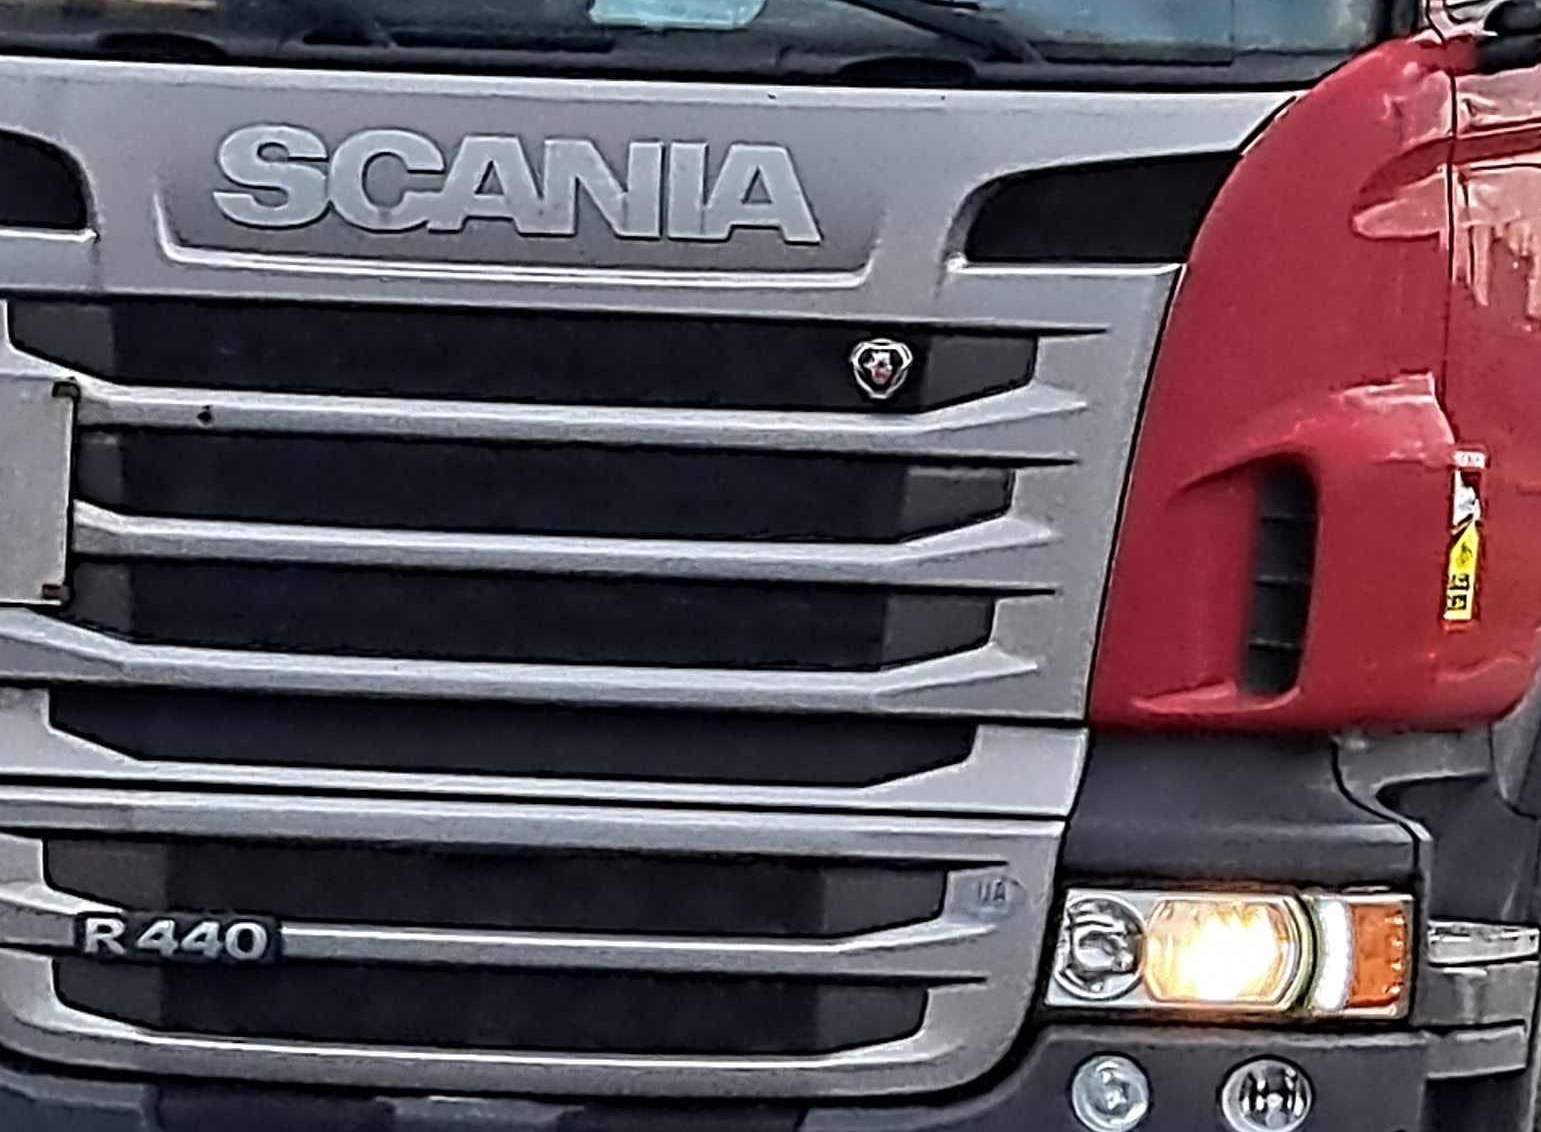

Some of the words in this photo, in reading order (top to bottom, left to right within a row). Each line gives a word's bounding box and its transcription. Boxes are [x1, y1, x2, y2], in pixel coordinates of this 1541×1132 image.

[212, 124, 823, 245] SCANIA
[84, 917, 126, 955] R
[136, 919, 268, 960] 440
